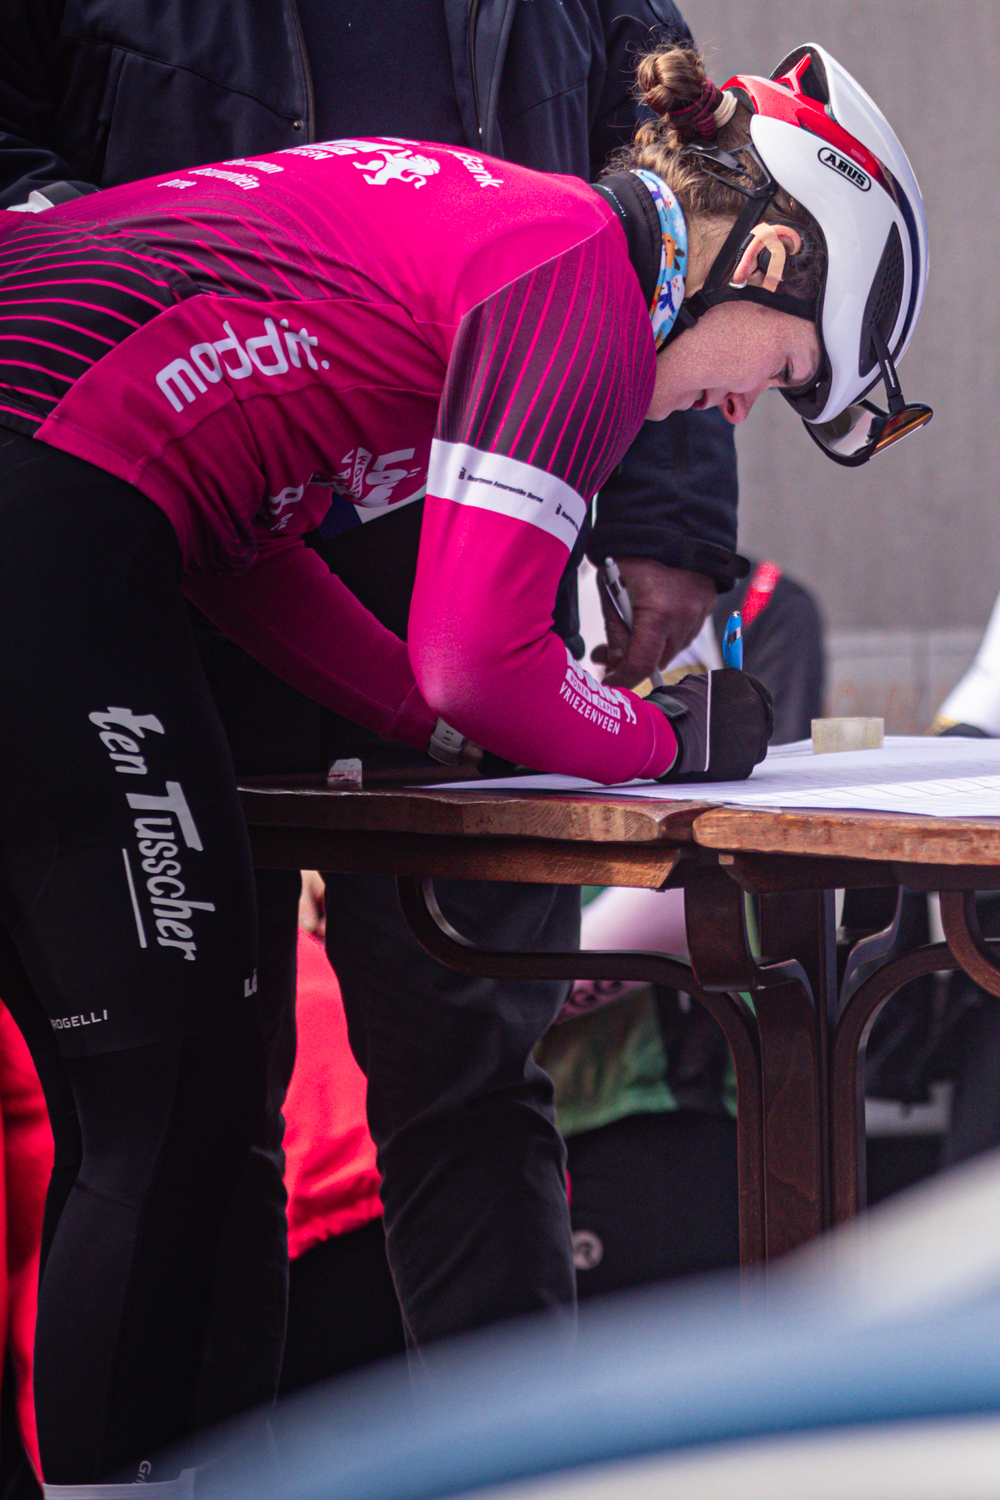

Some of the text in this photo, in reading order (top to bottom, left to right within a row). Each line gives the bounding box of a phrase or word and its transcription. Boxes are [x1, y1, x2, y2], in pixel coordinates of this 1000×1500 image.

[824, 153, 867, 187] ABUS
[559, 681, 621, 736] VRIEZENVEEN
[88, 706, 216, 961] ten Tusscher
